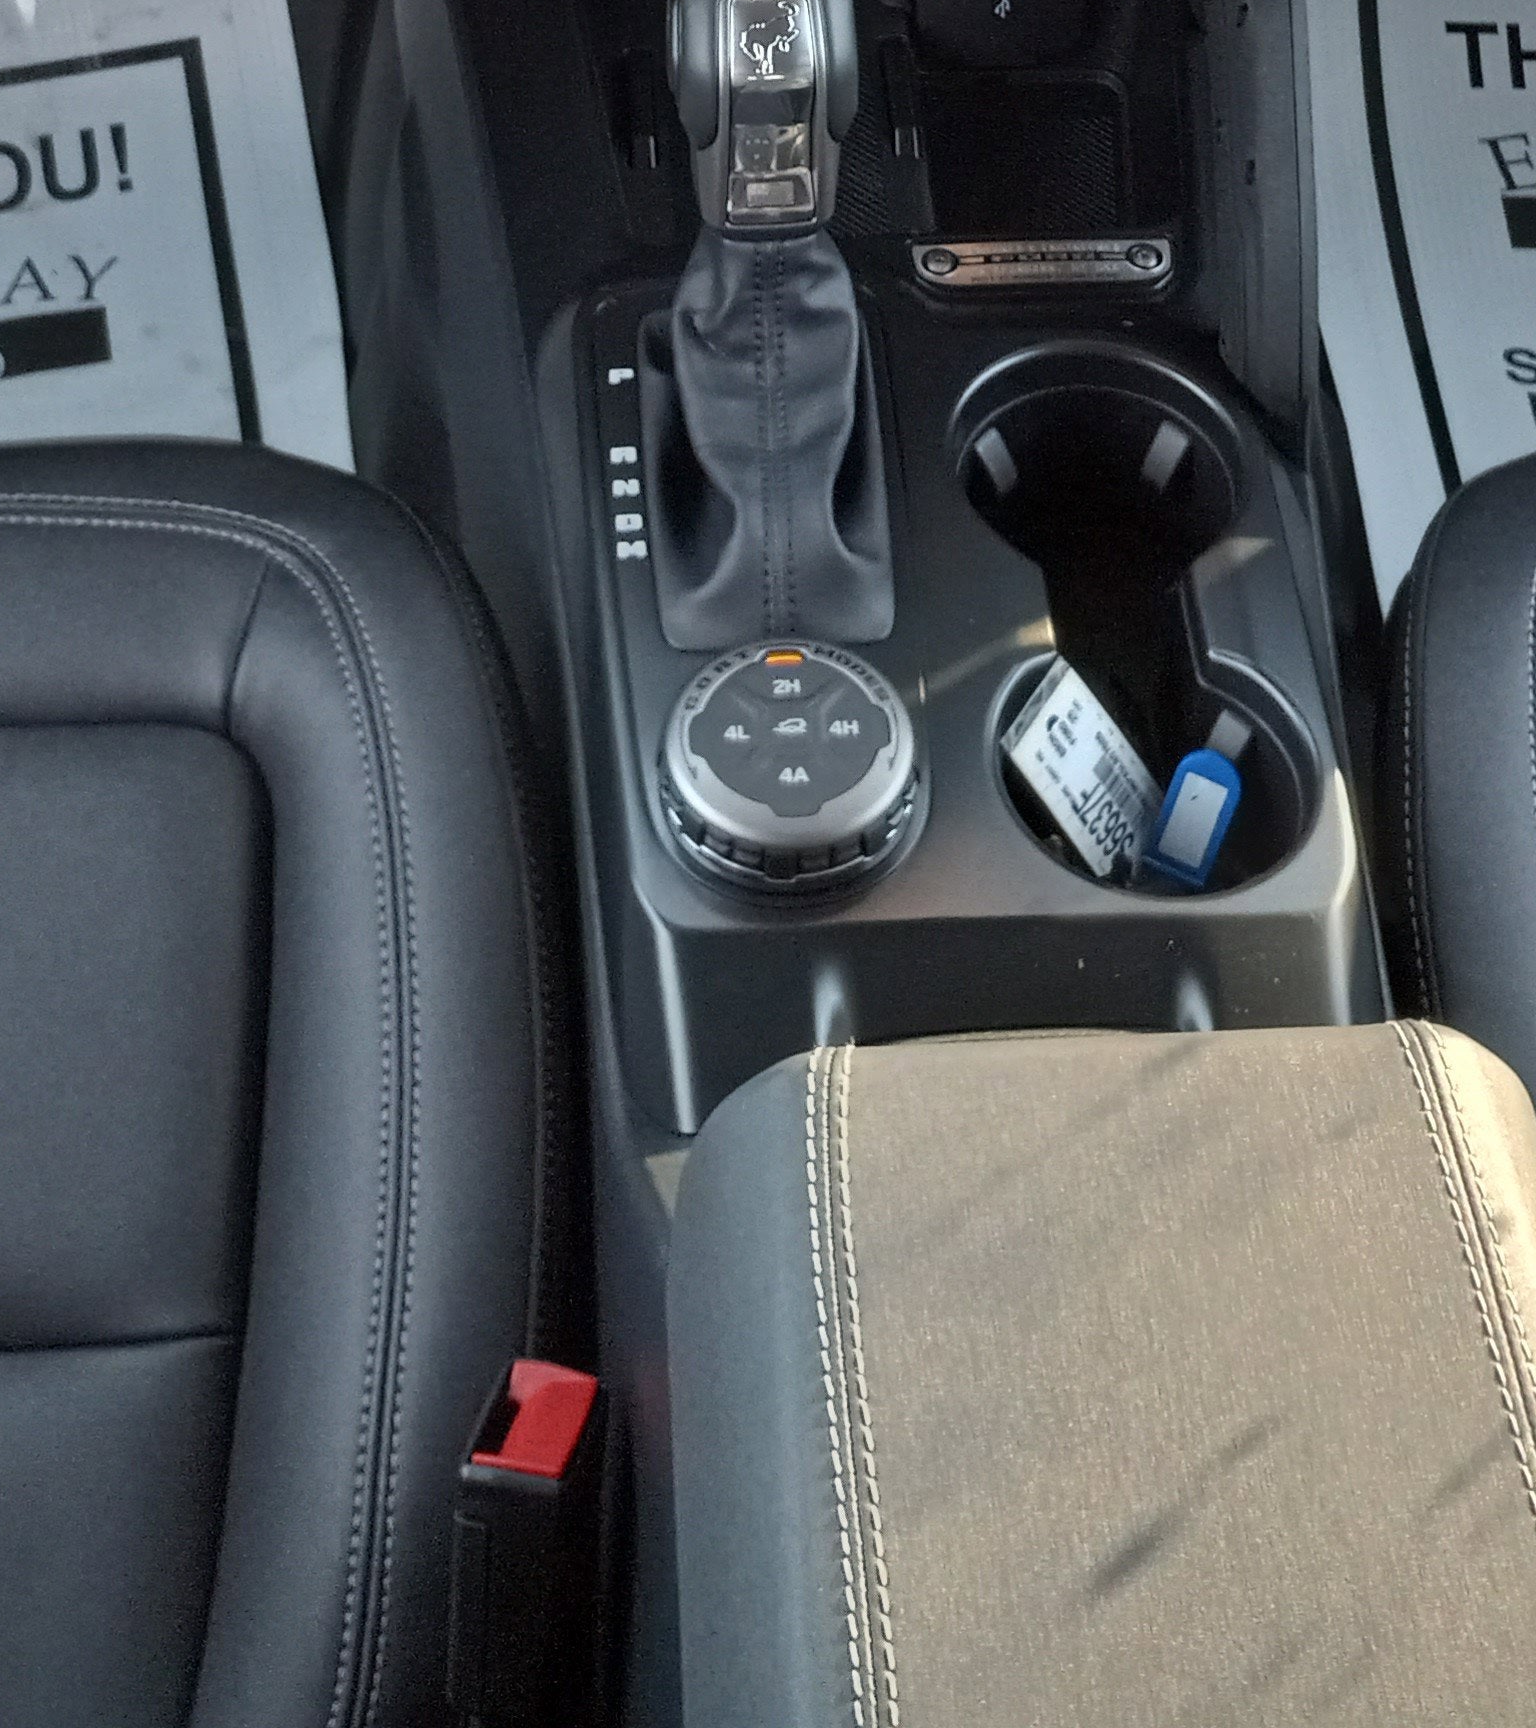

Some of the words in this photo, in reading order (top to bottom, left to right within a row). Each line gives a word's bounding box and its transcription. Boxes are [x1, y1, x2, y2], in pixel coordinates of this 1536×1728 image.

[607, 367, 635, 385] P
[609, 445, 639, 465] R
[611, 479, 641, 498] N
[614, 513, 644, 533] D
[615, 540, 648, 561] M
[772, 678, 802, 696] 2H
[722, 725, 751, 742] 4L
[828, 718, 859, 737] 4H
[777, 766, 810, 786] 4A
